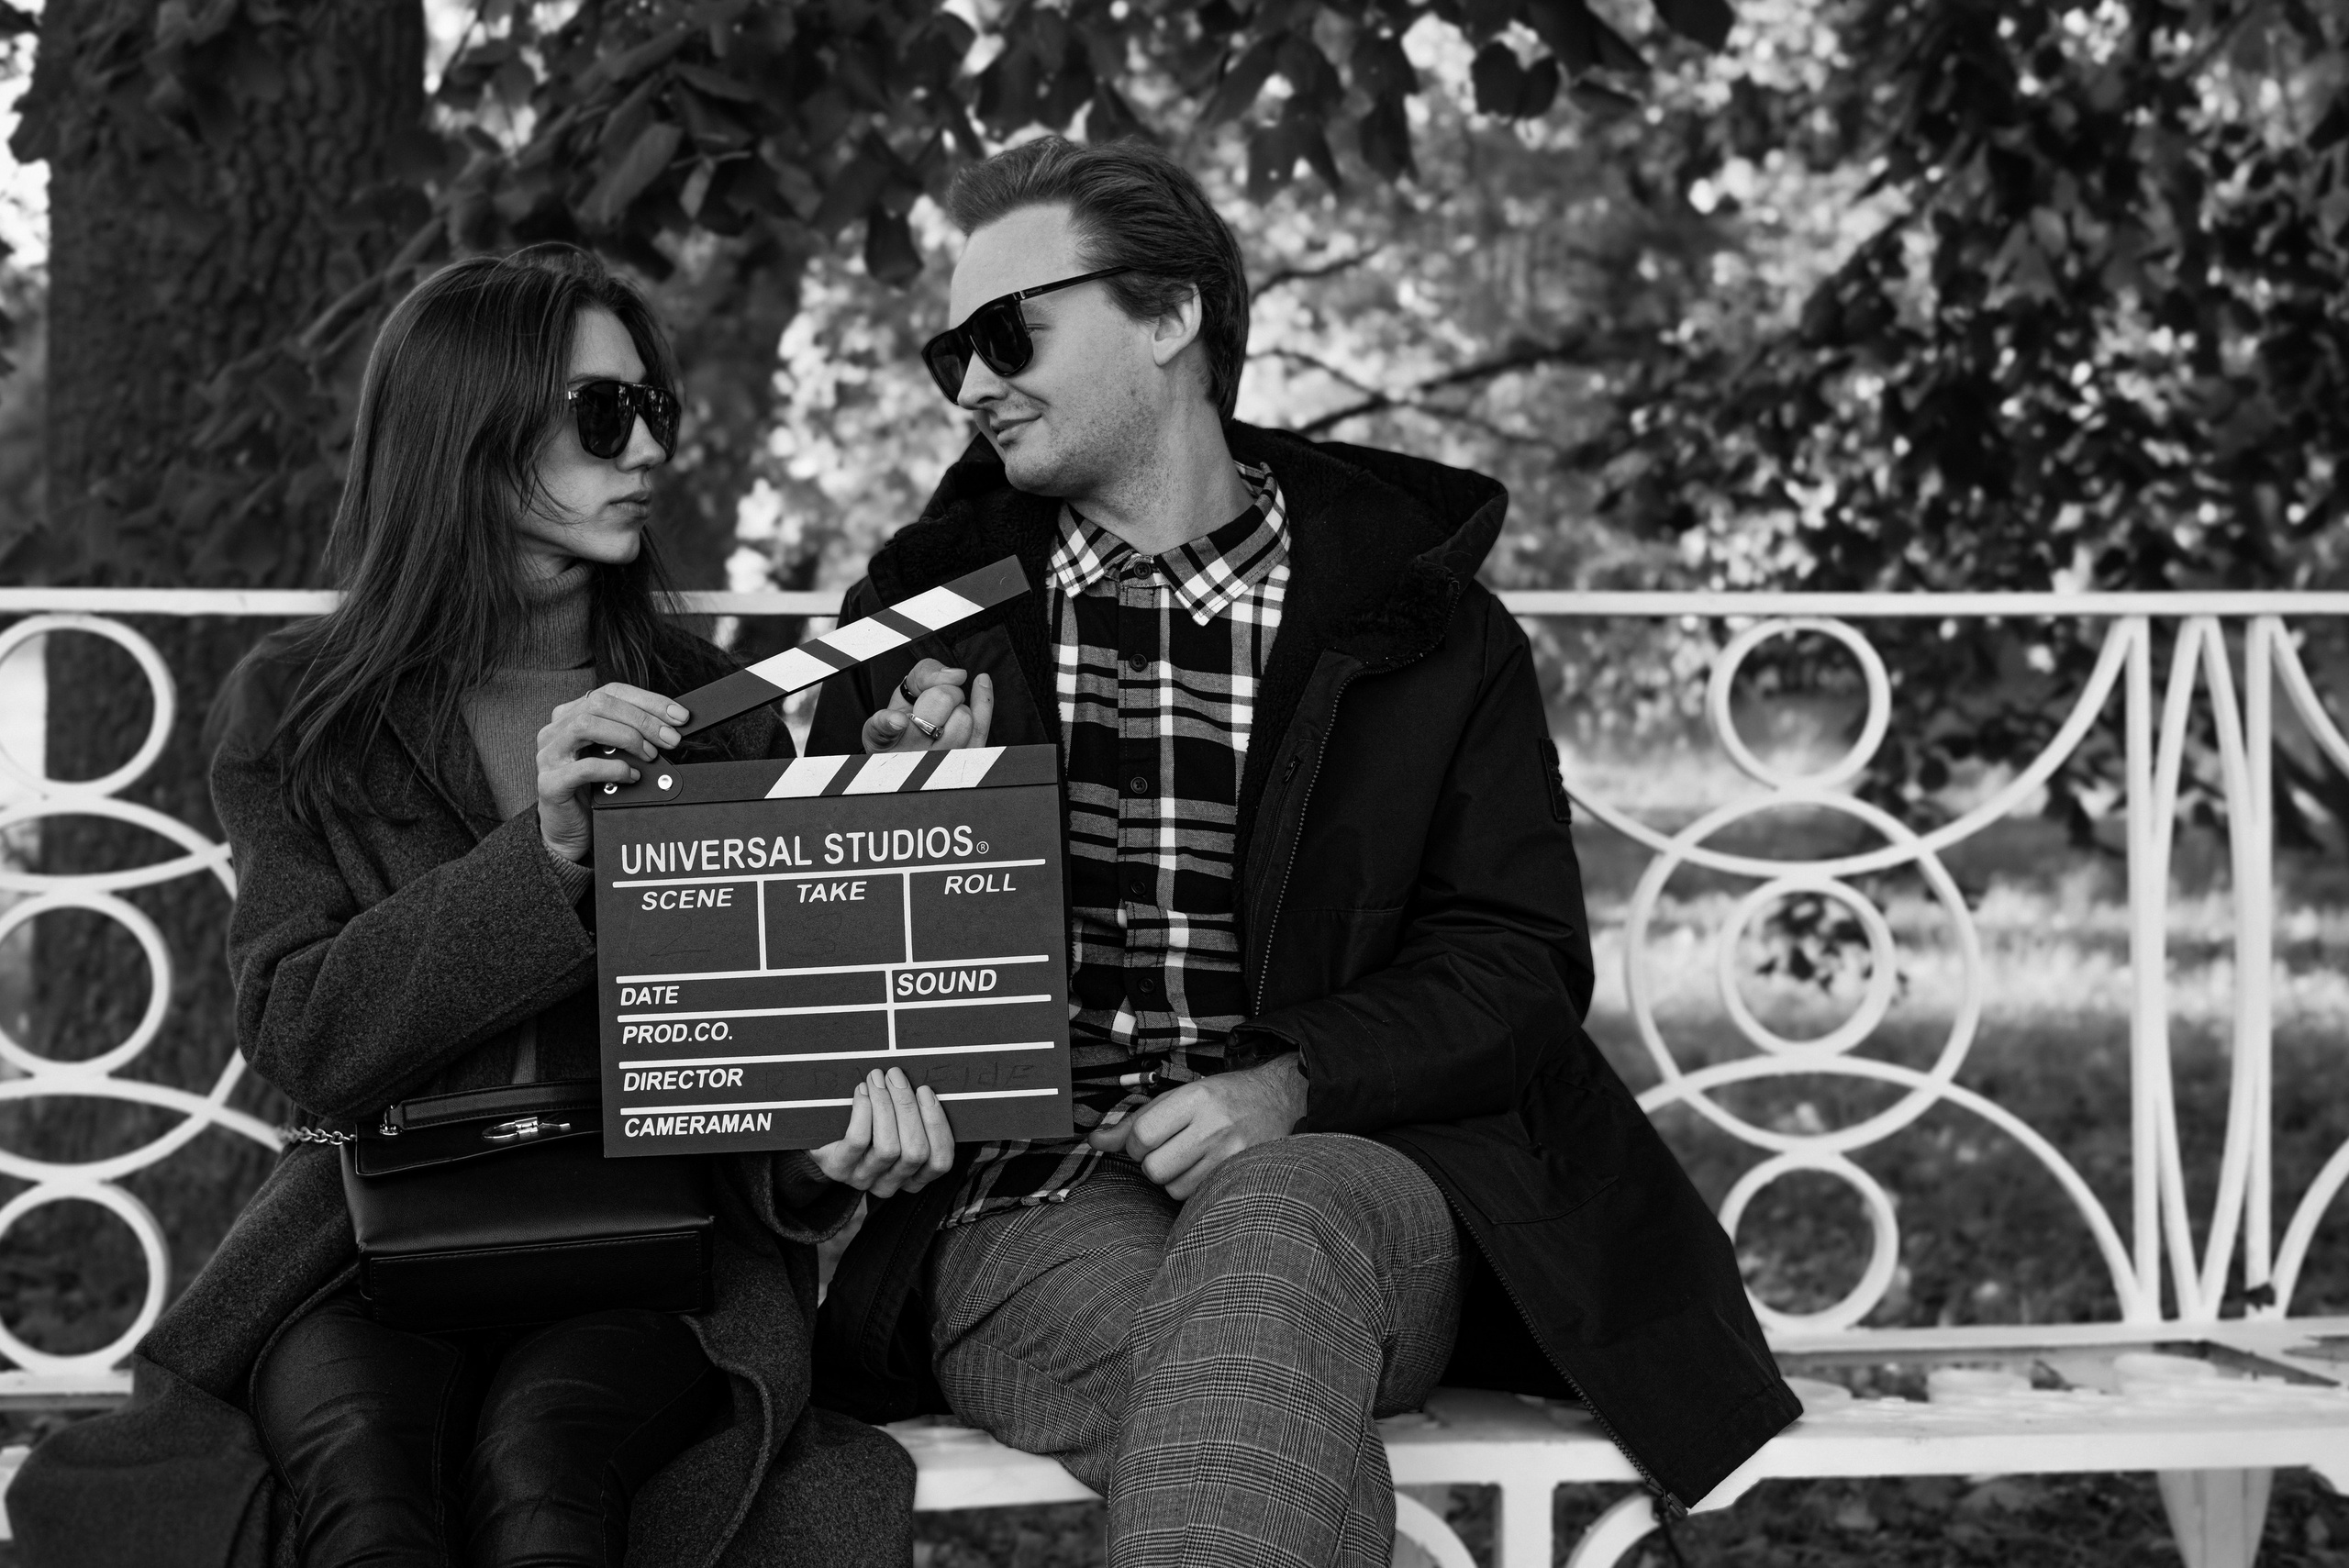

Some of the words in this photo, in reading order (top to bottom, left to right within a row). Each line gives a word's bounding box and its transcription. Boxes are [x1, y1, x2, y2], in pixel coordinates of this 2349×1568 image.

[621, 835, 813, 875] UNIVERSAL
[796, 881, 868, 904] TAKE
[943, 873, 1017, 895] ROLL
[640, 887, 734, 911] SCENE
[896, 969, 997, 996] SOUND
[620, 984, 680, 1006] DATE
[622, 1021, 733, 1045] PROD.CO.
[623, 1067, 744, 1092] DIRECTOR
[624, 1112, 773, 1138] CAMERAMAN
